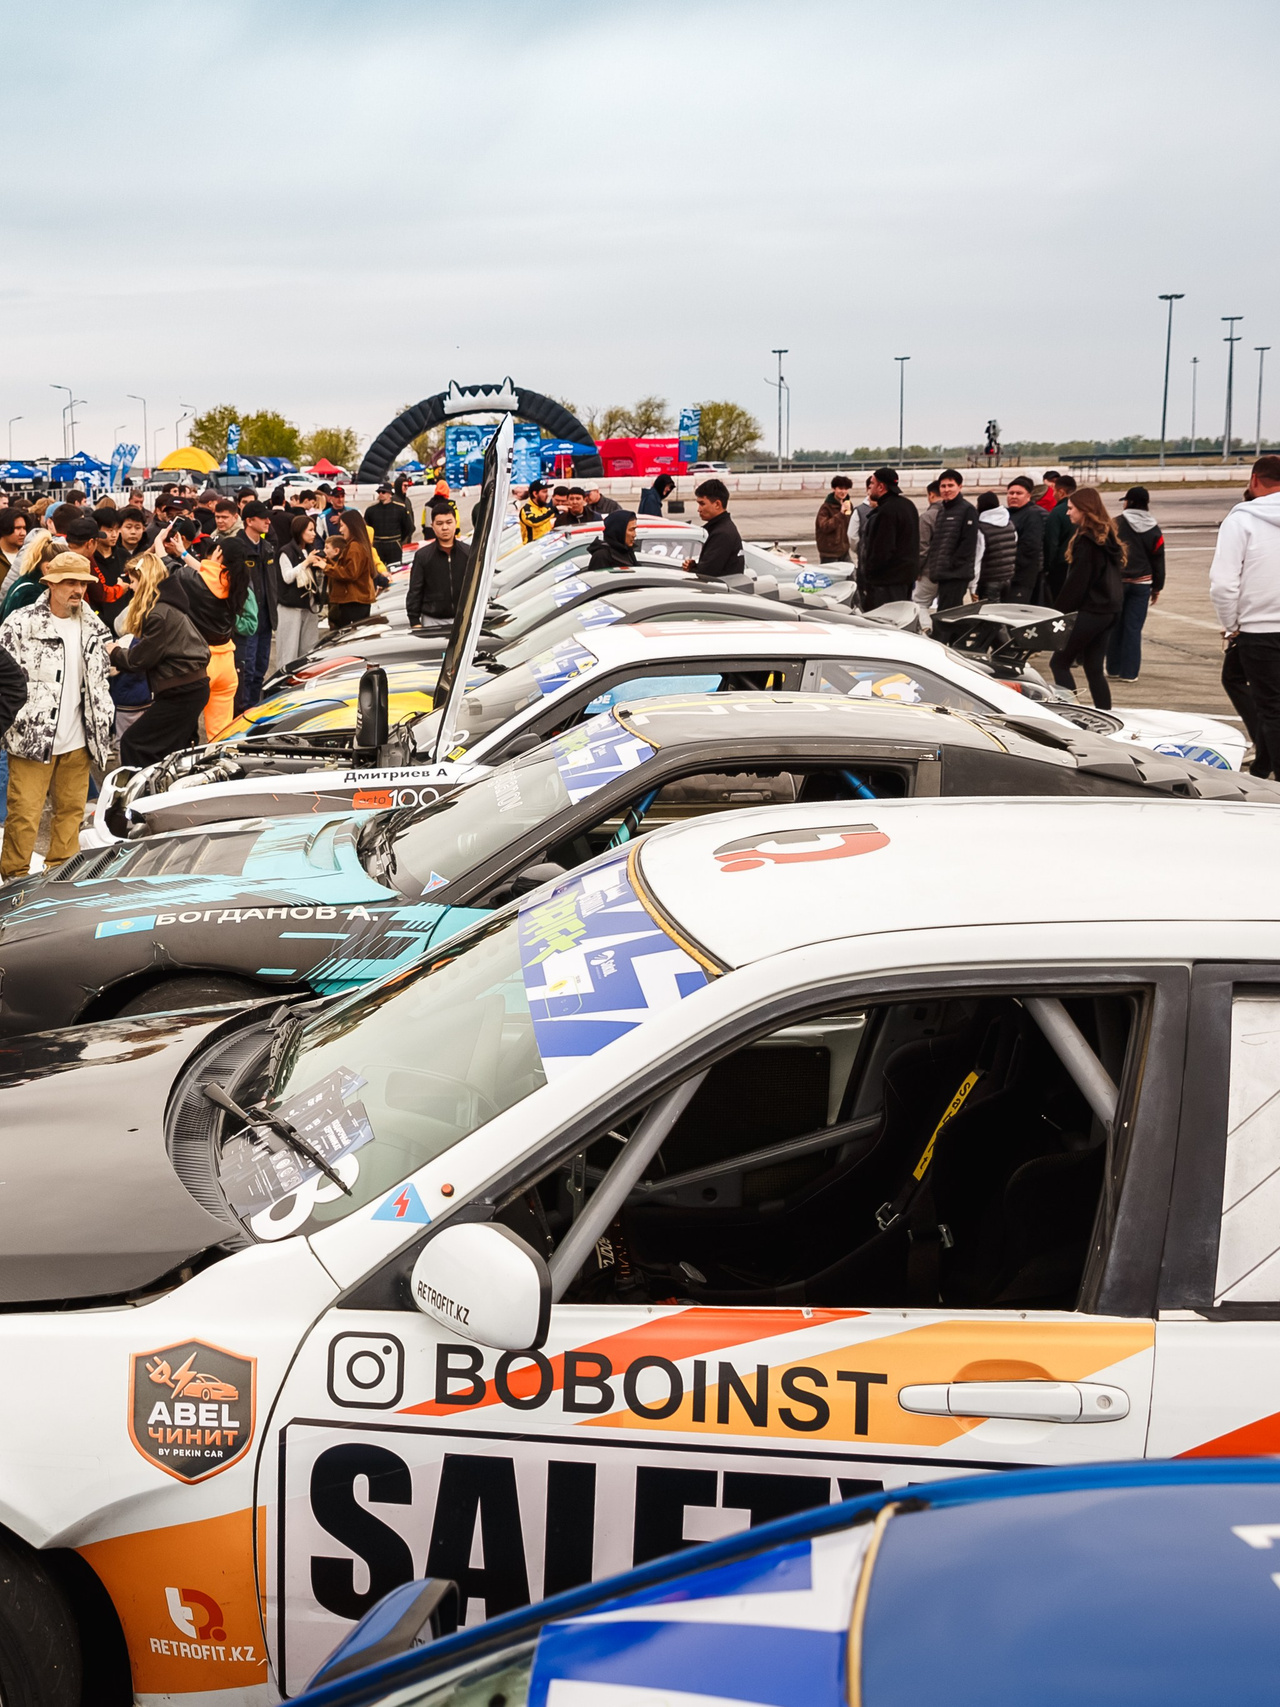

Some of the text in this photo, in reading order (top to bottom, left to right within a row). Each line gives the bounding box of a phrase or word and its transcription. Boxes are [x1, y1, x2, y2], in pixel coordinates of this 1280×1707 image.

[344, 768, 448, 783] Дмитриев А
[155, 905, 379, 926] БОГДАНОВ А.
[417, 1280, 470, 1326] RETROFIT.KZ
[435, 1343, 888, 1436] BOBOINST
[147, 1401, 240, 1427] ABEL
[148, 1427, 238, 1446] ЧИНИТ
[158, 1448, 223, 1458] BY PEKIN CAR
[149, 1637, 256, 1662] RETROFIT.KZ
